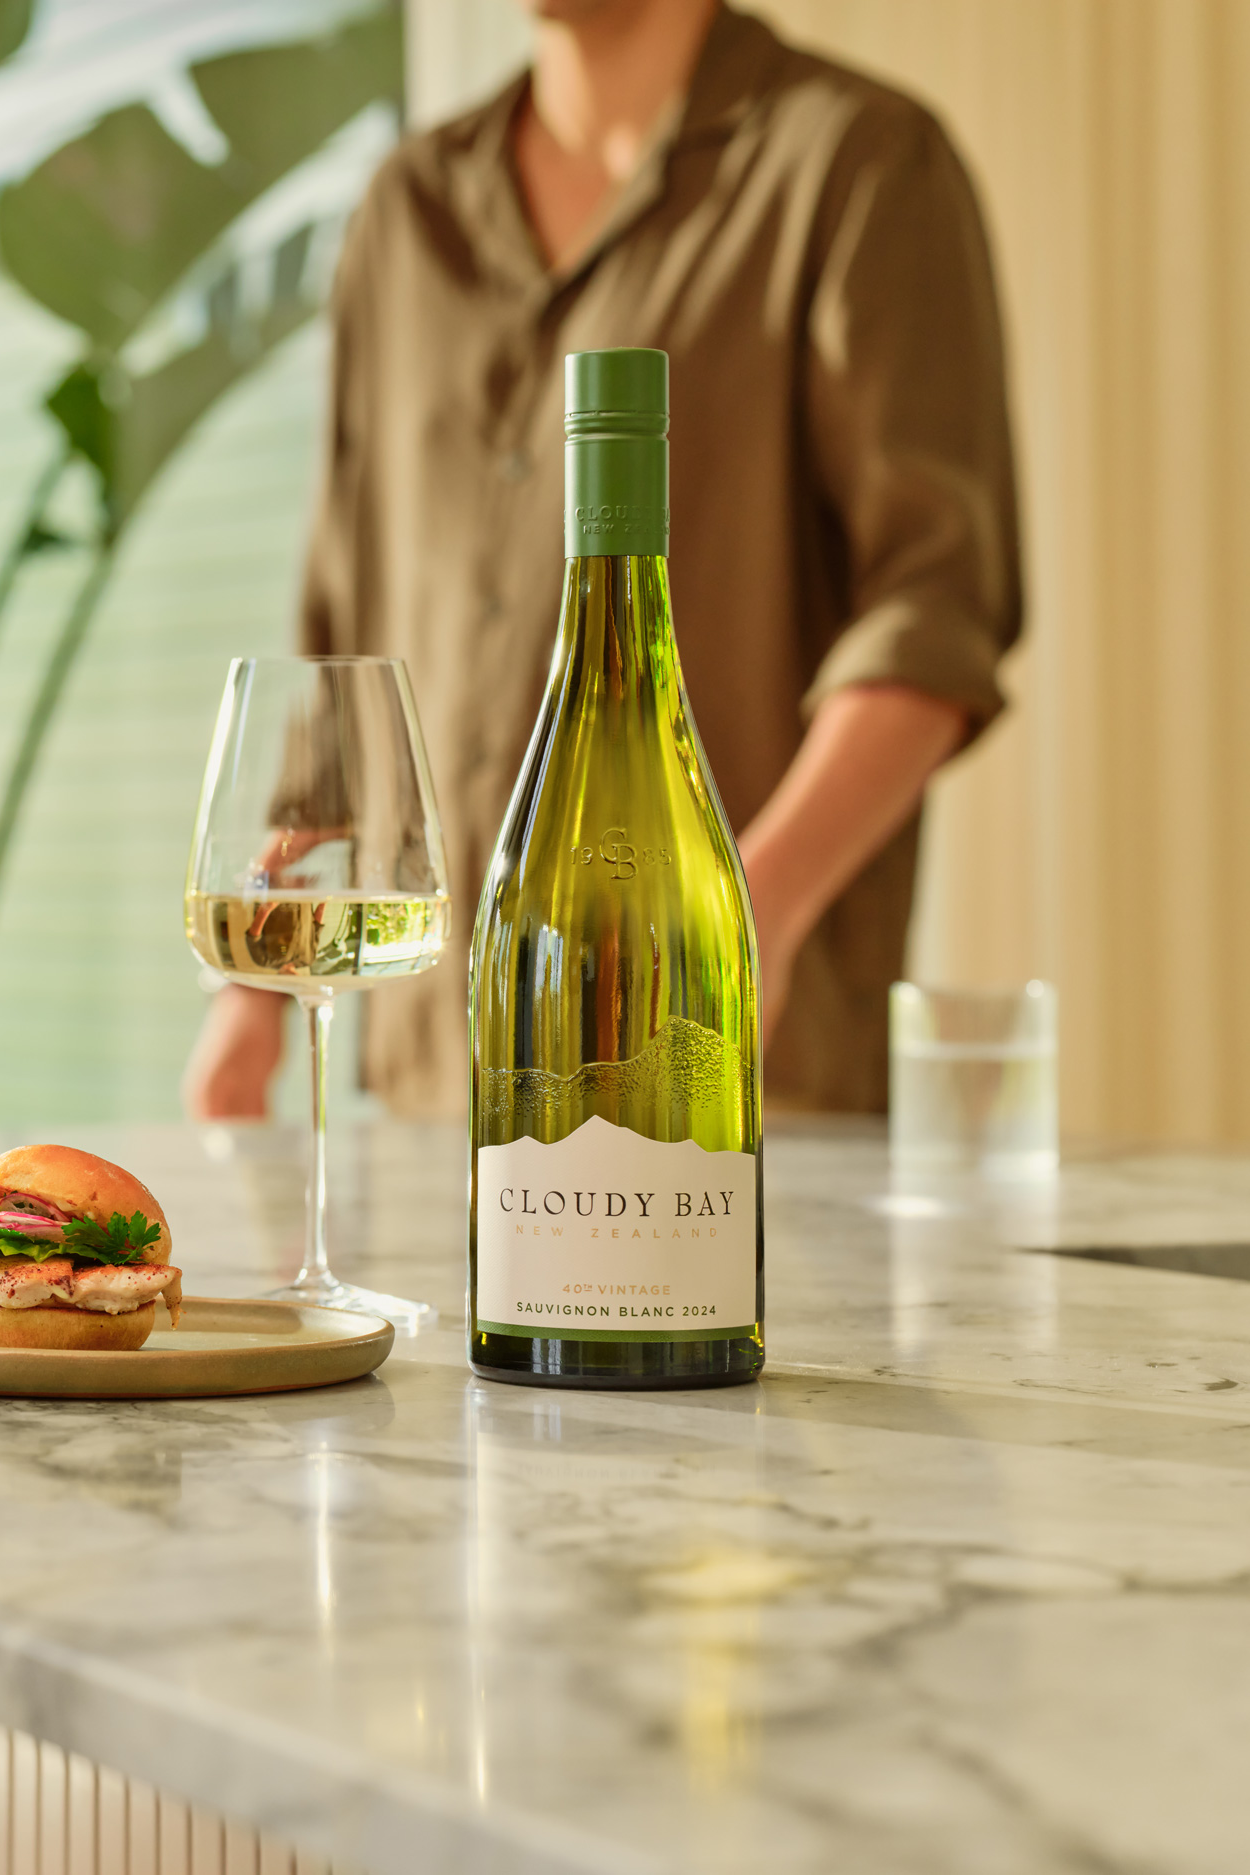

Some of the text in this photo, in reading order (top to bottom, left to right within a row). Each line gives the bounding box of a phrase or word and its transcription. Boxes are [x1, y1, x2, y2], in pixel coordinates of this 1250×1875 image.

[575, 505, 653, 521] CLOU
[583, 524, 614, 535] NEW
[500, 1187, 734, 1217] CLOUDY BAY
[516, 1224, 717, 1239] NEW ZEALAND
[597, 1285, 671, 1296] VINTAGE
[516, 1301, 716, 1317] SAUVIGNON BLANC 2024
